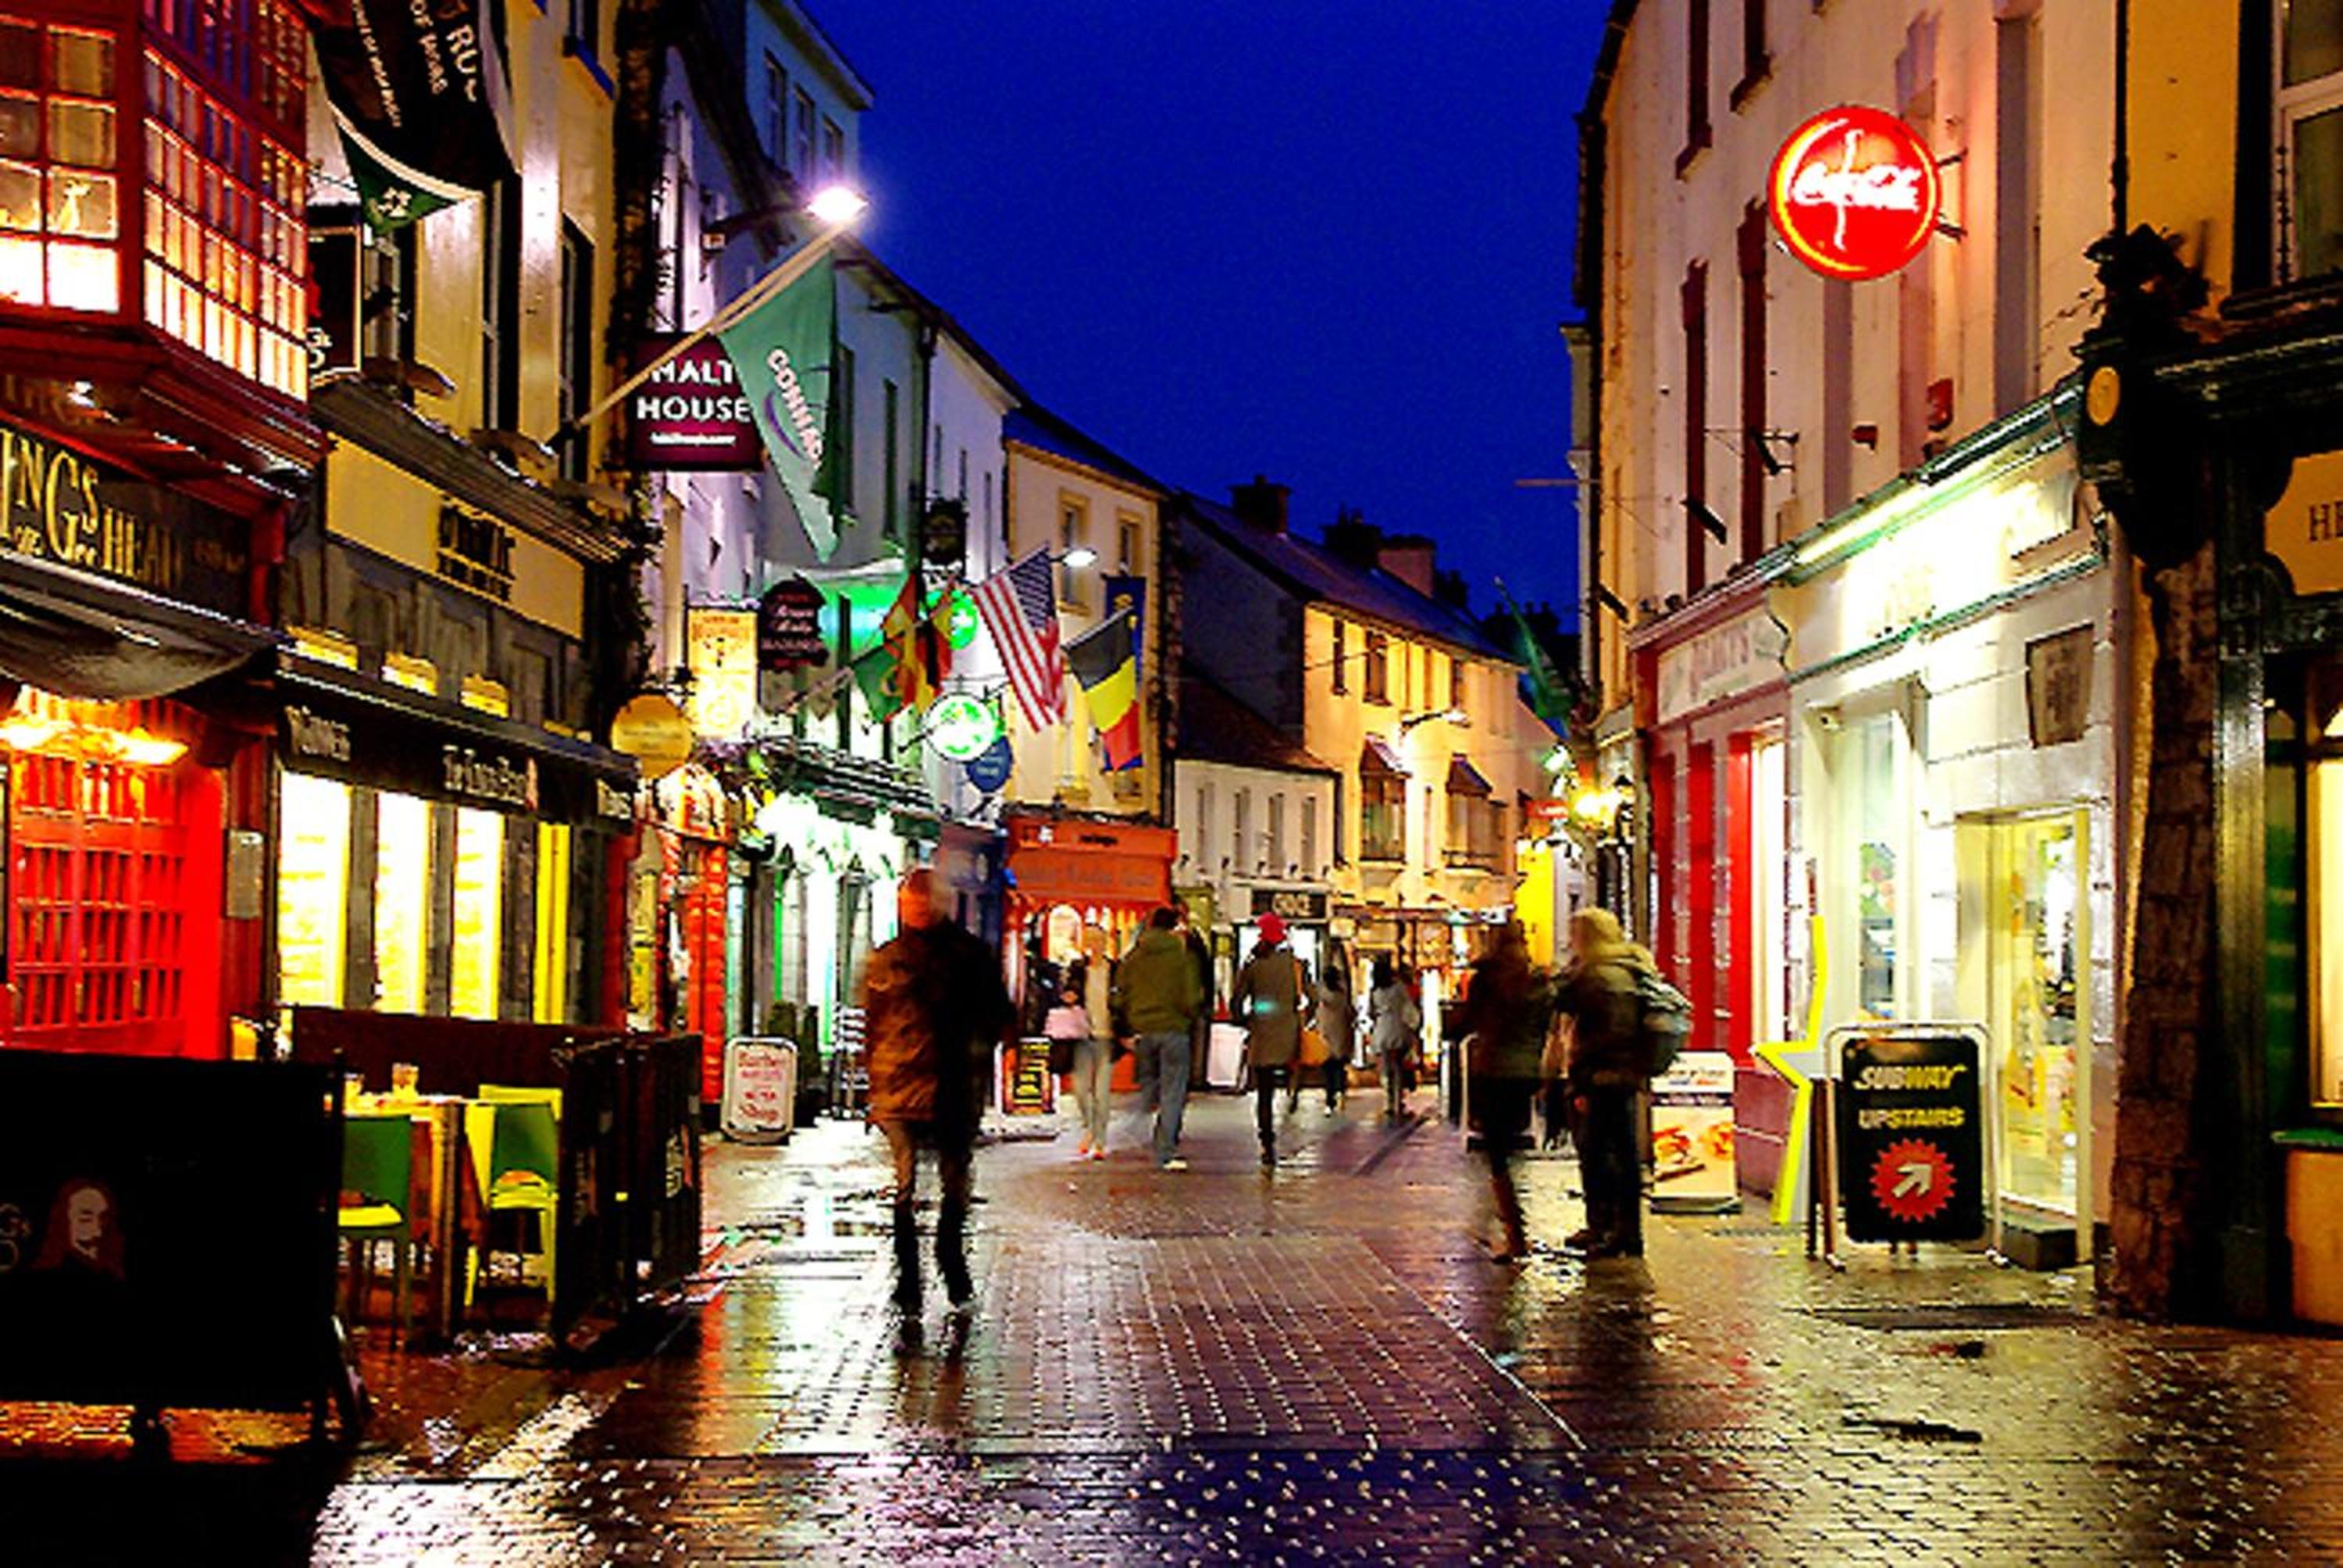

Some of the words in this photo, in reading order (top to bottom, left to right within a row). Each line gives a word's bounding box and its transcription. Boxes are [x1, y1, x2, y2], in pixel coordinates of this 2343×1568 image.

[651, 359, 733, 384] MALT
[637, 396, 752, 422] HOUSE
[1852, 1064, 1968, 1091] SUBWAY
[1857, 1107, 1966, 1130] UPSTAIRS
